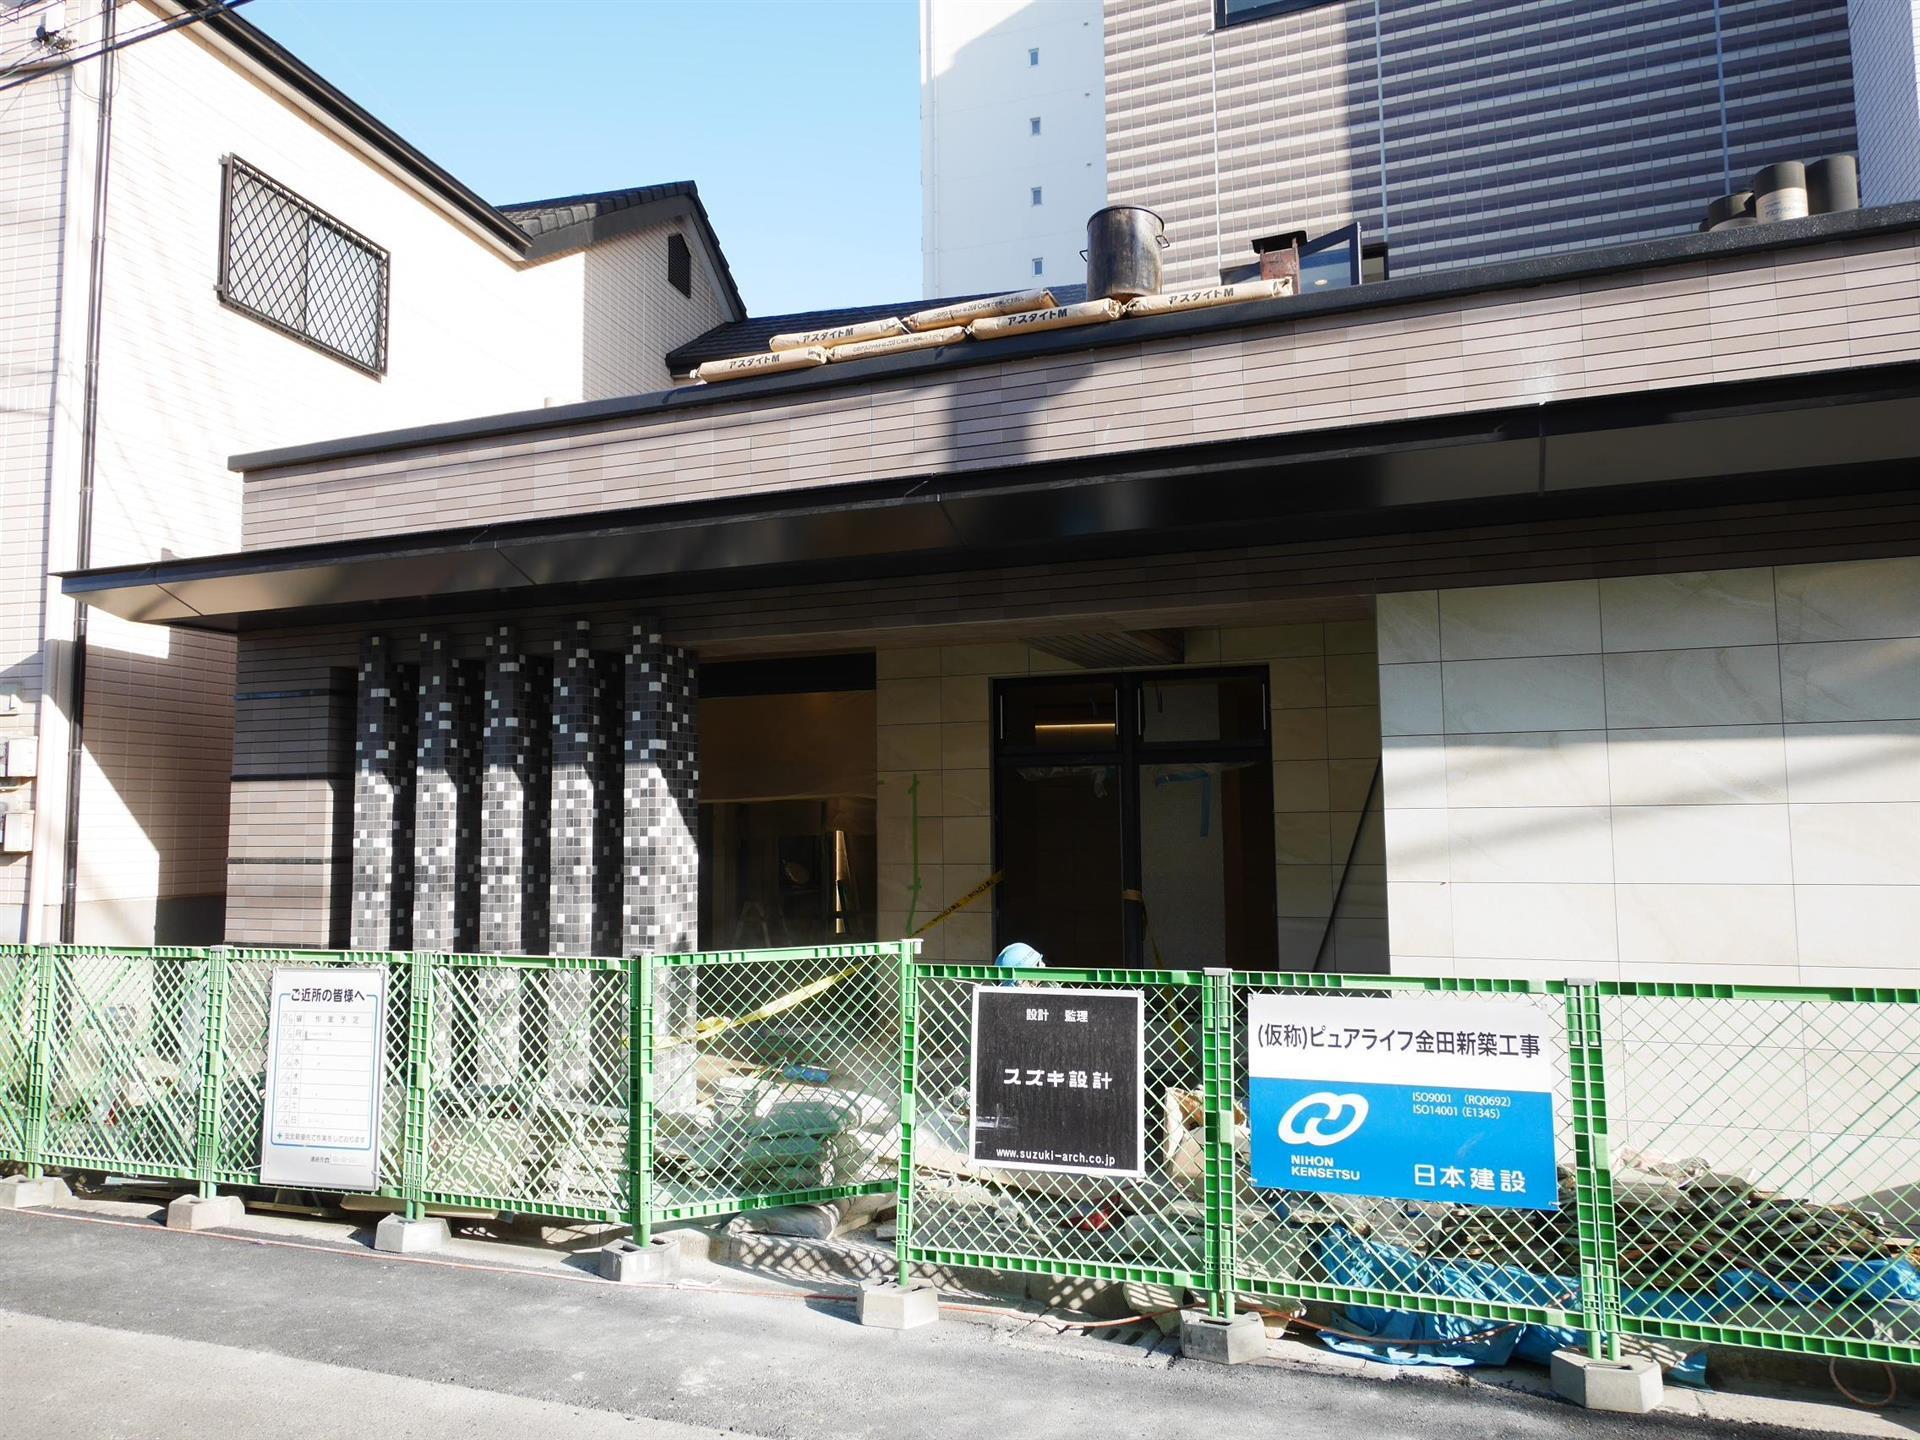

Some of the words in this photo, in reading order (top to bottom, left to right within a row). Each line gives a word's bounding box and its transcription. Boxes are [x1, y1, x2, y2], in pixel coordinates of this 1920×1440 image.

[1008, 308, 1068, 326] アスタイトM
[291, 988, 365, 1003] ご近所の皆様へ
[1026, 1008, 1050, 1021] 設計
[1064, 1009, 1088, 1023] 監理
[1258, 1023, 1541, 1059] (仮称)ピュアライフ金田新築工事
[1003, 1068, 1113, 1090] スズキ設計
[1412, 1092, 1451, 1103] ISO9001
[1412, 1104, 1458, 1116] ISO14001
[1462, 1107, 1501, 1119] (E1345)
[996, 1148, 1116, 1166] www.suzuki-arch.co.jp
[1291, 1155, 1334, 1167] NIHON
[1291, 1166, 1361, 1181] KENSETSU
[1414, 1164, 1527, 1193] 日本建設
